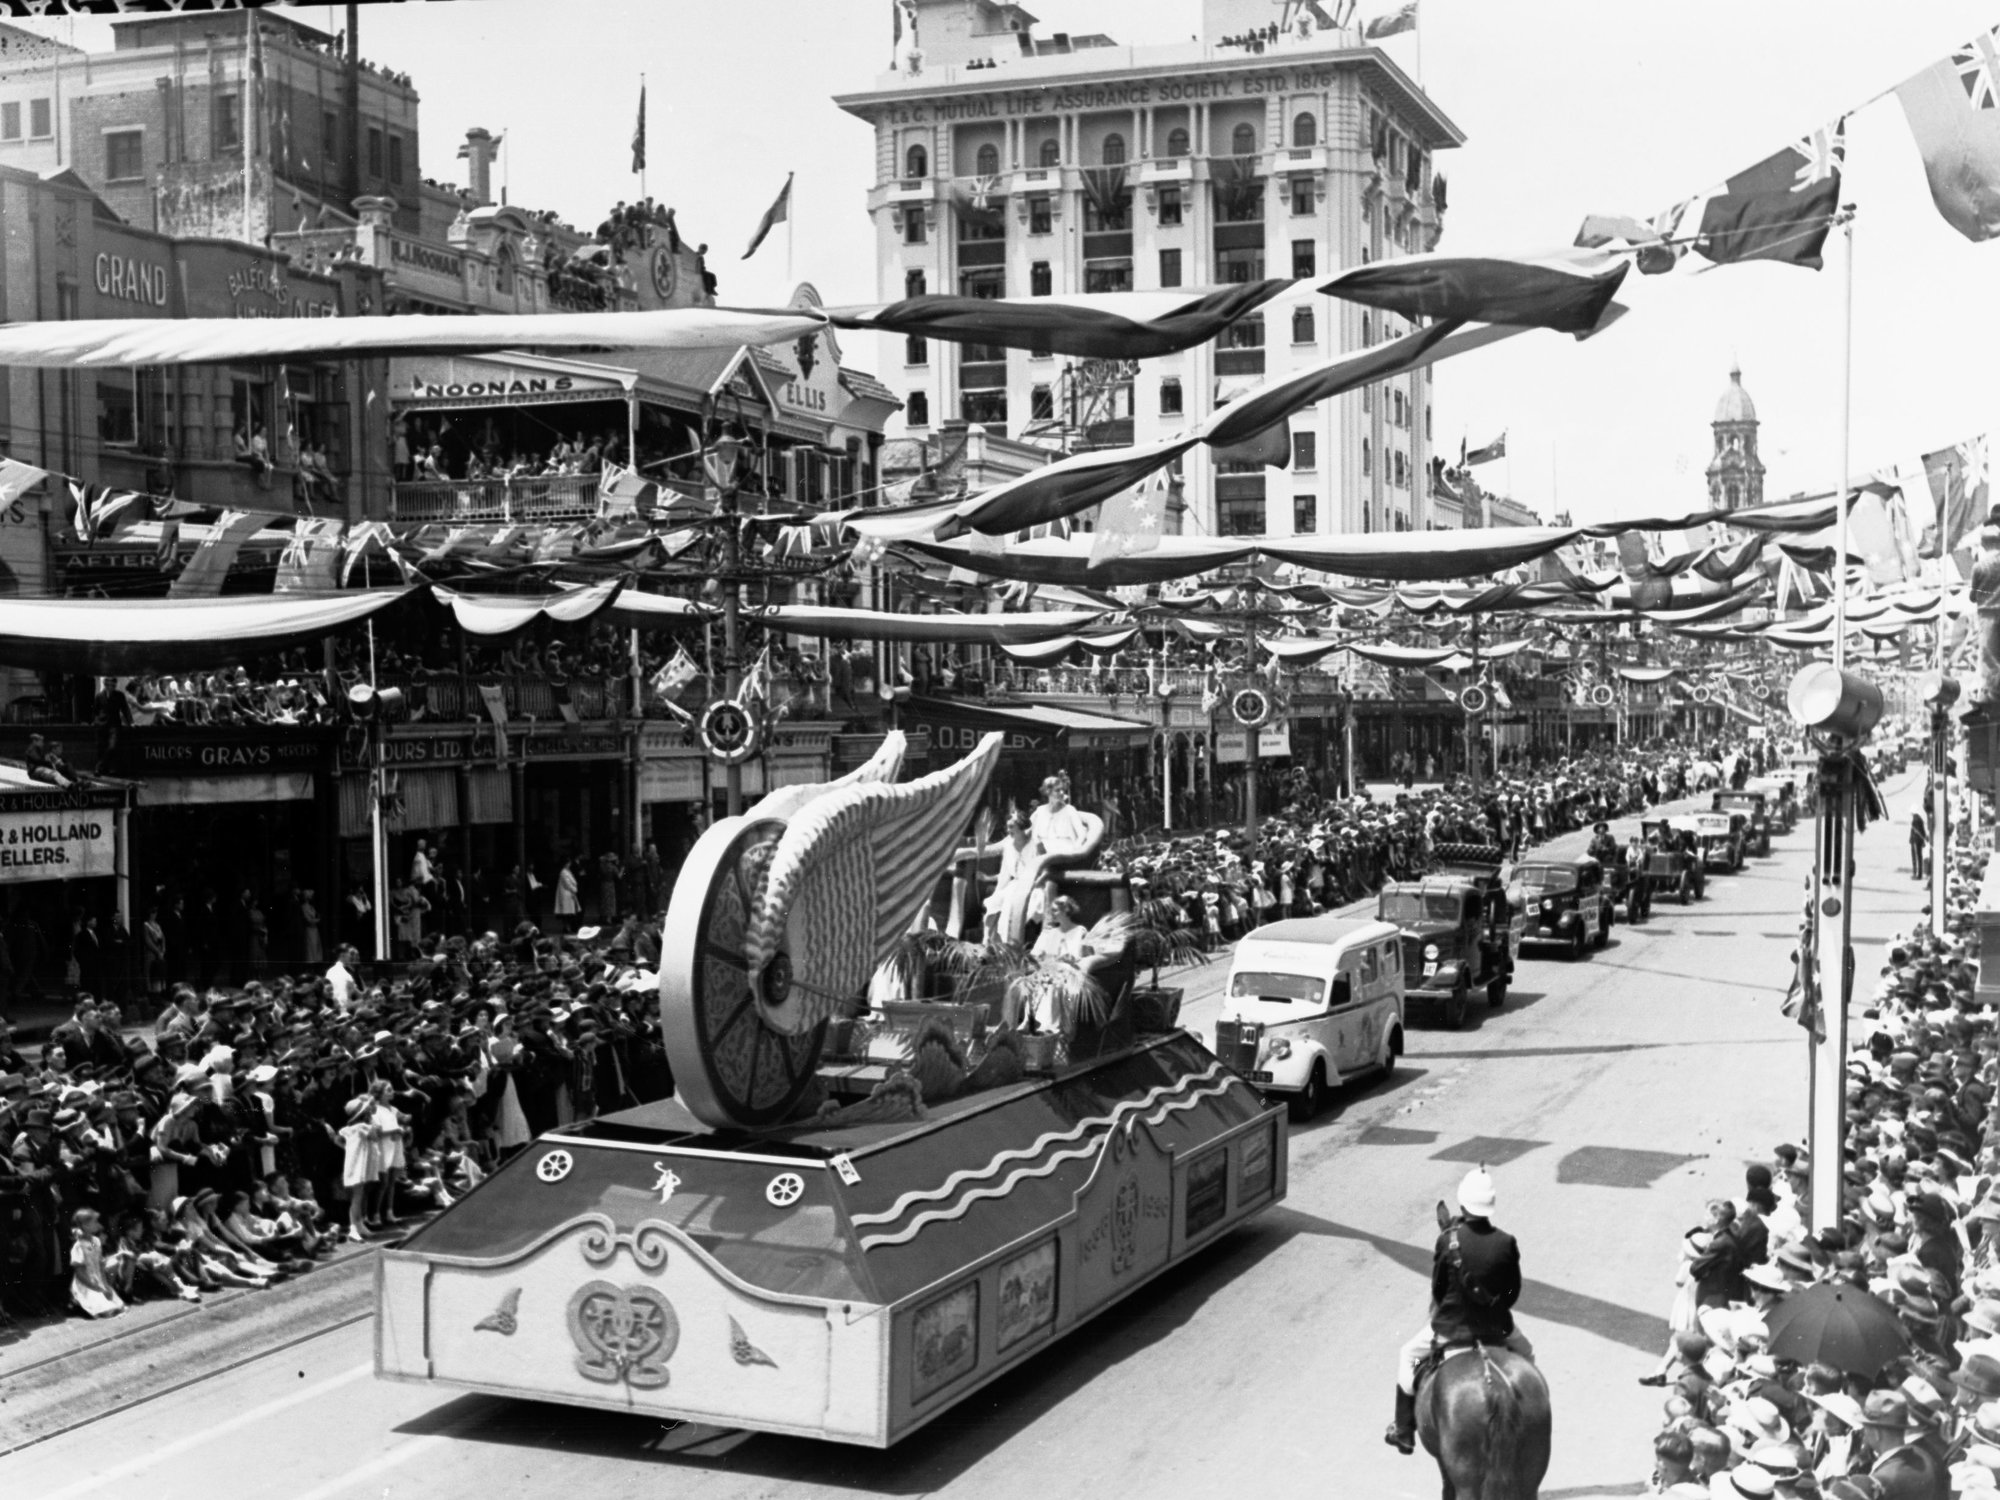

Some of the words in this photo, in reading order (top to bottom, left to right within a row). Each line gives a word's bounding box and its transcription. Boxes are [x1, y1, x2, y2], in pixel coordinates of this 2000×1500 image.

[934, 99, 998, 120] MUTUAL
[1007, 95, 1042, 114] LIFE
[1053, 86, 1150, 110] ASSURANCE
[95, 252, 167, 306] GRAND
[786, 382, 827, 412] ELLIS
[144, 745, 192, 760] TAILORS
[201, 746, 271, 766] GRAYS
[432, 738, 464, 759] LTD.
[471, 738, 515, 758] CAE
[23, 792, 89, 810] HOLLAND
[9, 829, 18, 844] &
[22, 823, 102, 844] HOLLAND
[1, 847, 70, 867] ELLERS.
